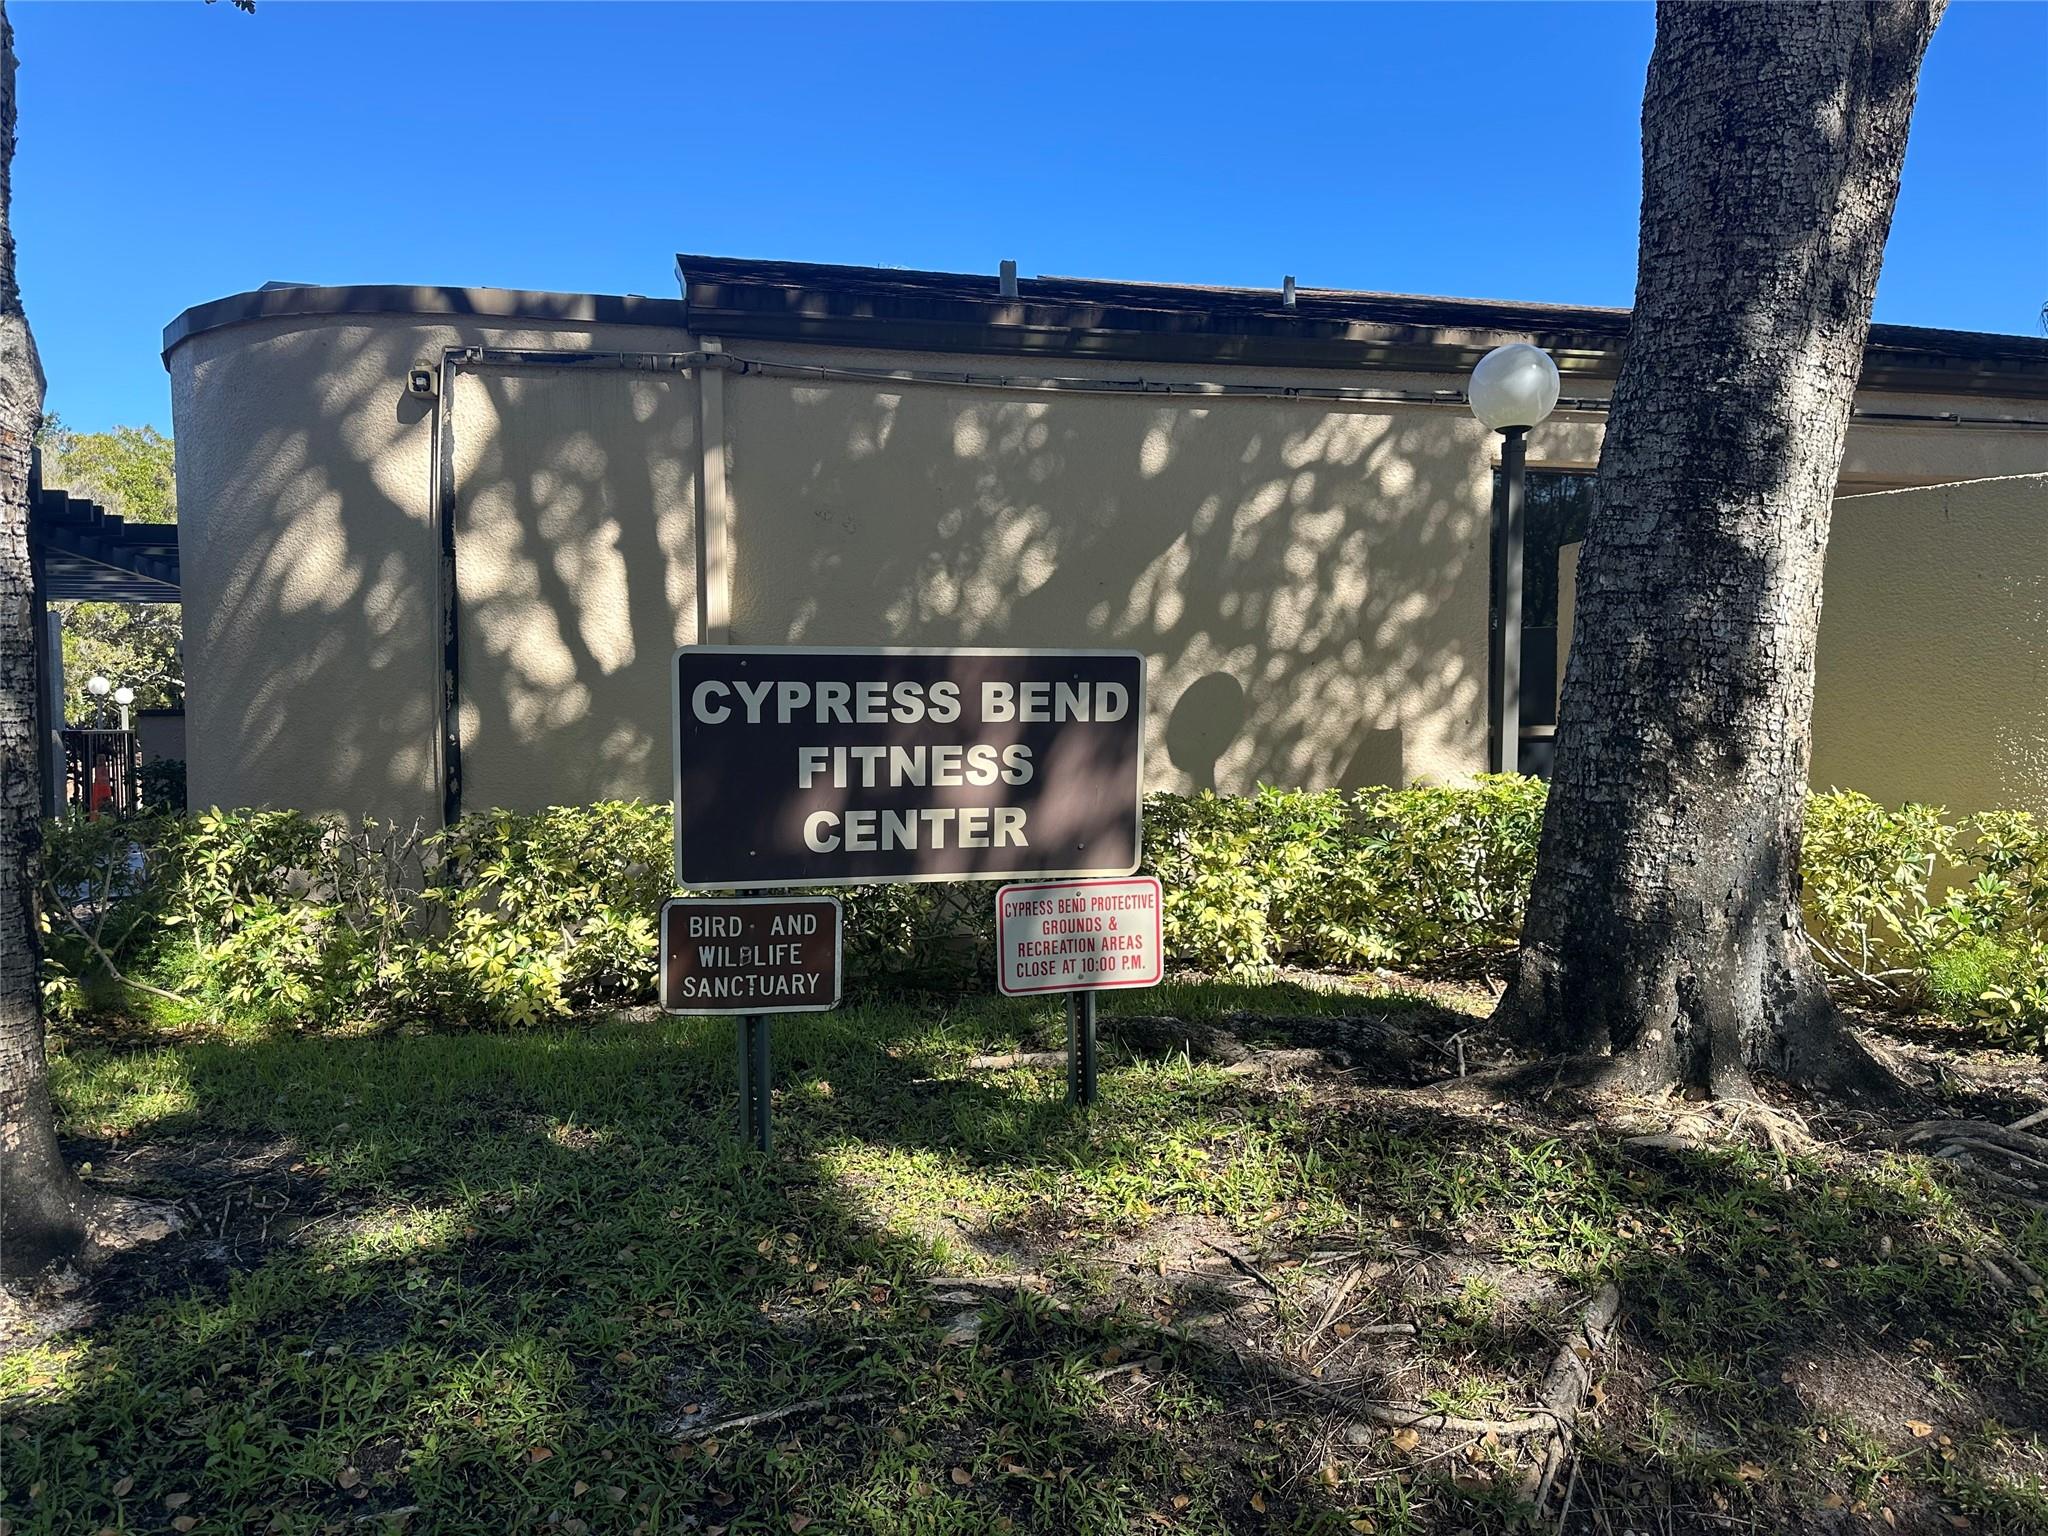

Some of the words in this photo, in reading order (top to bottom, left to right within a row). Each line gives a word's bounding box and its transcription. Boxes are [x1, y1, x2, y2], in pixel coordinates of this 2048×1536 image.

[691, 680, 962, 724] CYPRESS
[981, 681, 1130, 723] BEND
[798, 744, 1034, 789] FITNESS
[803, 807, 1029, 853] CENTER
[1005, 900, 1053, 918] CYPRESS
[1058, 898, 1086, 914] BEND
[1091, 894, 1154, 912] PROTECTIVE
[690, 916, 742, 938] BIRD
[771, 914, 817, 936] AND
[1043, 917, 1101, 935] GROUNDS
[1108, 916, 1118, 931] &
[1018, 938, 1095, 957] RECREATION
[1101, 935, 1143, 951] AREAS
[1017, 961, 1056, 977] CLOSE
[1062, 959, 1076, 974] AT
[1082, 956, 1115, 973] 10:00
[1122, 955, 1146, 970] P.M.
[683, 973, 820, 998] SANCTUARY
